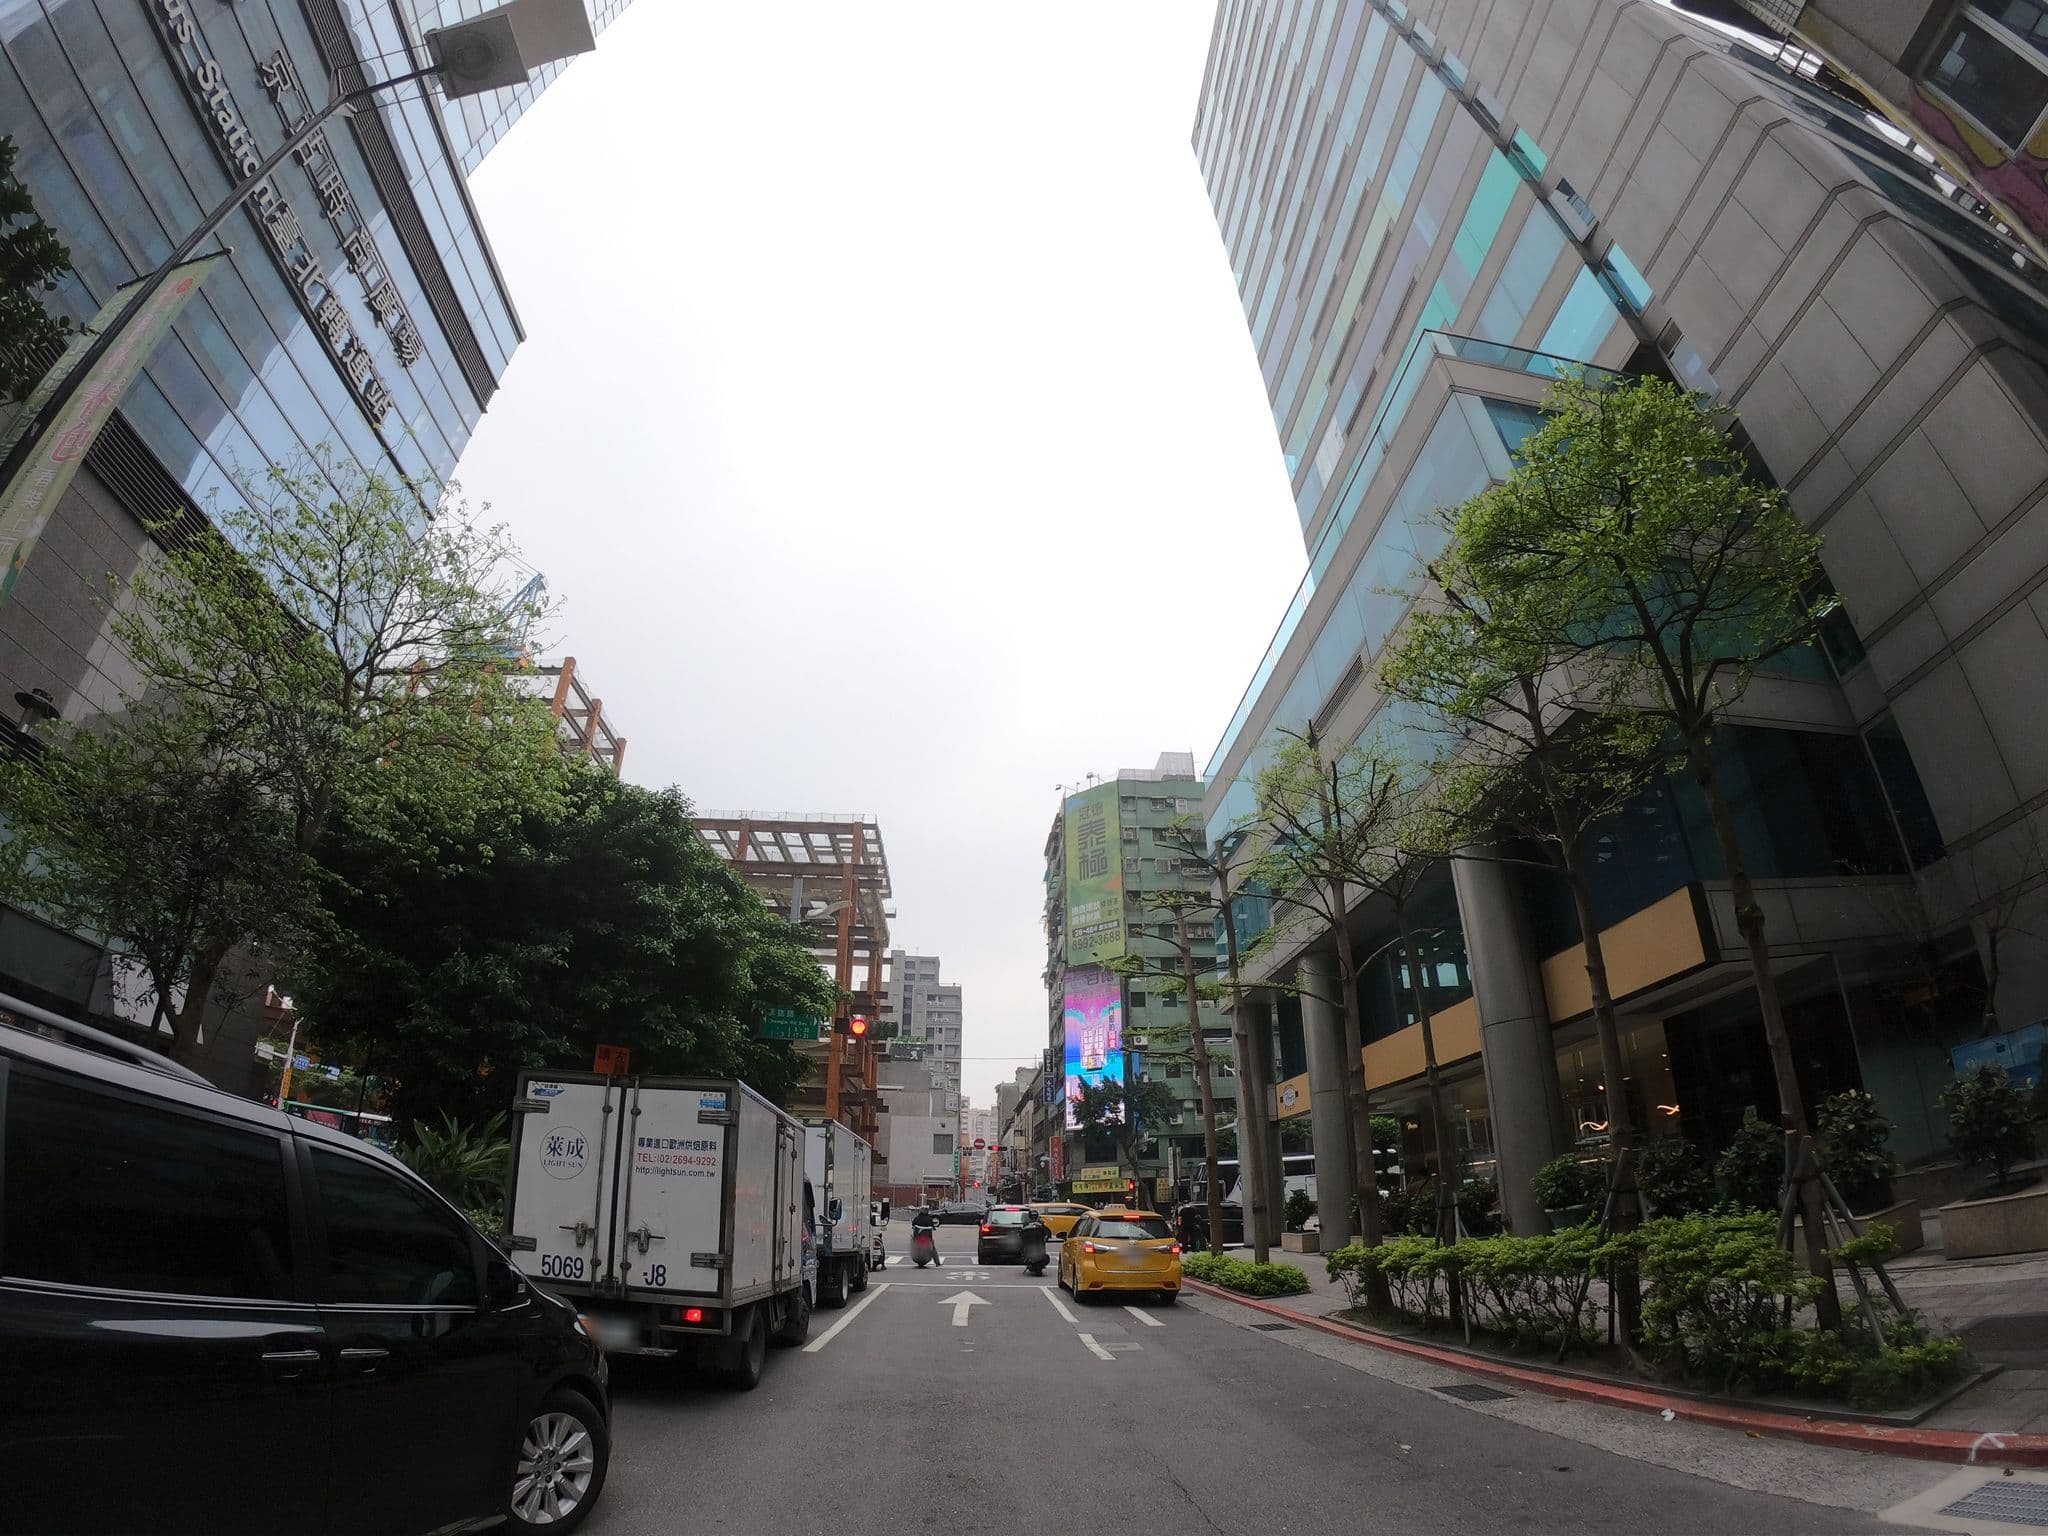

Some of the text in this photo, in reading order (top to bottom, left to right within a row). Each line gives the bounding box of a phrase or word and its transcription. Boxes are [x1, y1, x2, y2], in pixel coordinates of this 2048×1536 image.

[197, 59, 275, 219] Station
[261, 50, 424, 368] 京站時尚廣場
[264, 199, 394, 425] 臺北轉運站
[1072, 931, 1121, 951] 8992-3688
[543, 1159, 567, 1168] LIGHT
[541, 1254, 584, 1279] 5069
